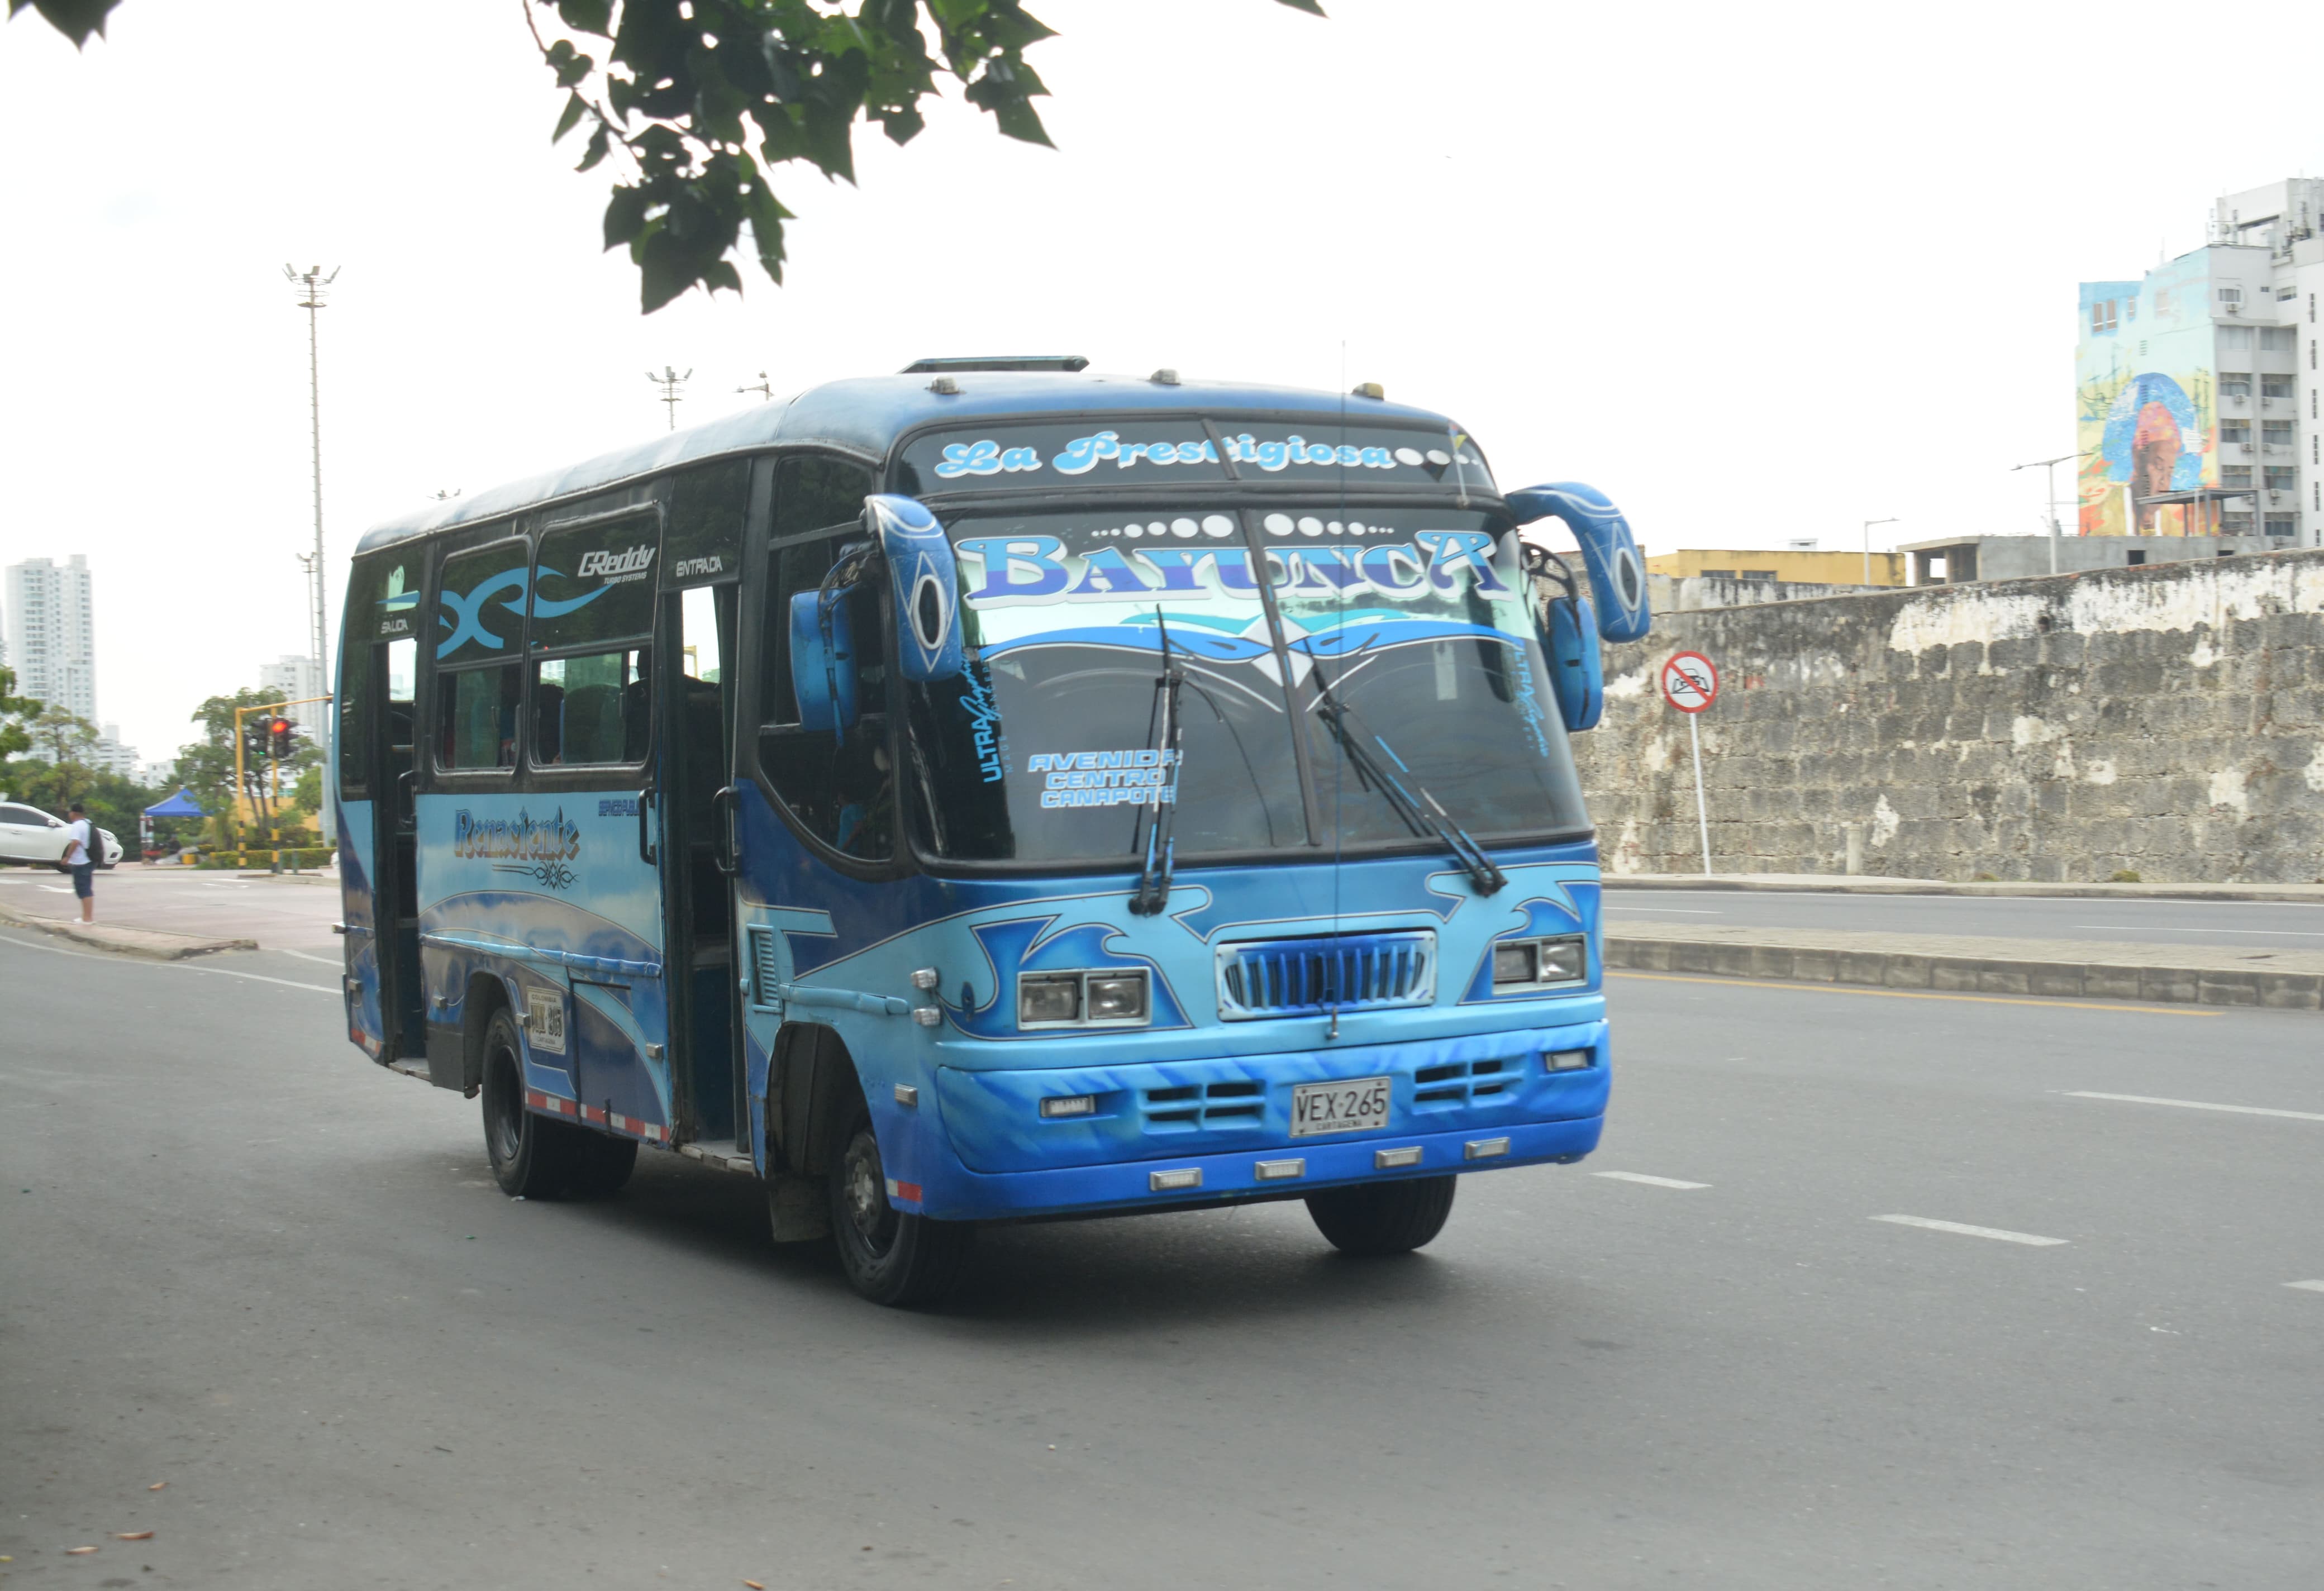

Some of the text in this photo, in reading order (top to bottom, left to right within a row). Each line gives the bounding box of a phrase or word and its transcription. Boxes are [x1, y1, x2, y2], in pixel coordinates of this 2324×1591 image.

[935, 431, 1397, 479] La Prestigiosa
[604, 571, 647, 585] TURBO SYSTEMS
[676, 556, 722, 577] ENTRADA
[954, 531, 1514, 611] BAYUNCA
[971, 717, 1004, 783] ULTRA
[1028, 749, 1184, 772] AVENIDA
[1046, 768, 1167, 789] CENTRO
[1040, 785, 1177, 808] CANAPOTE
[455, 805, 580, 861] Renaciente
